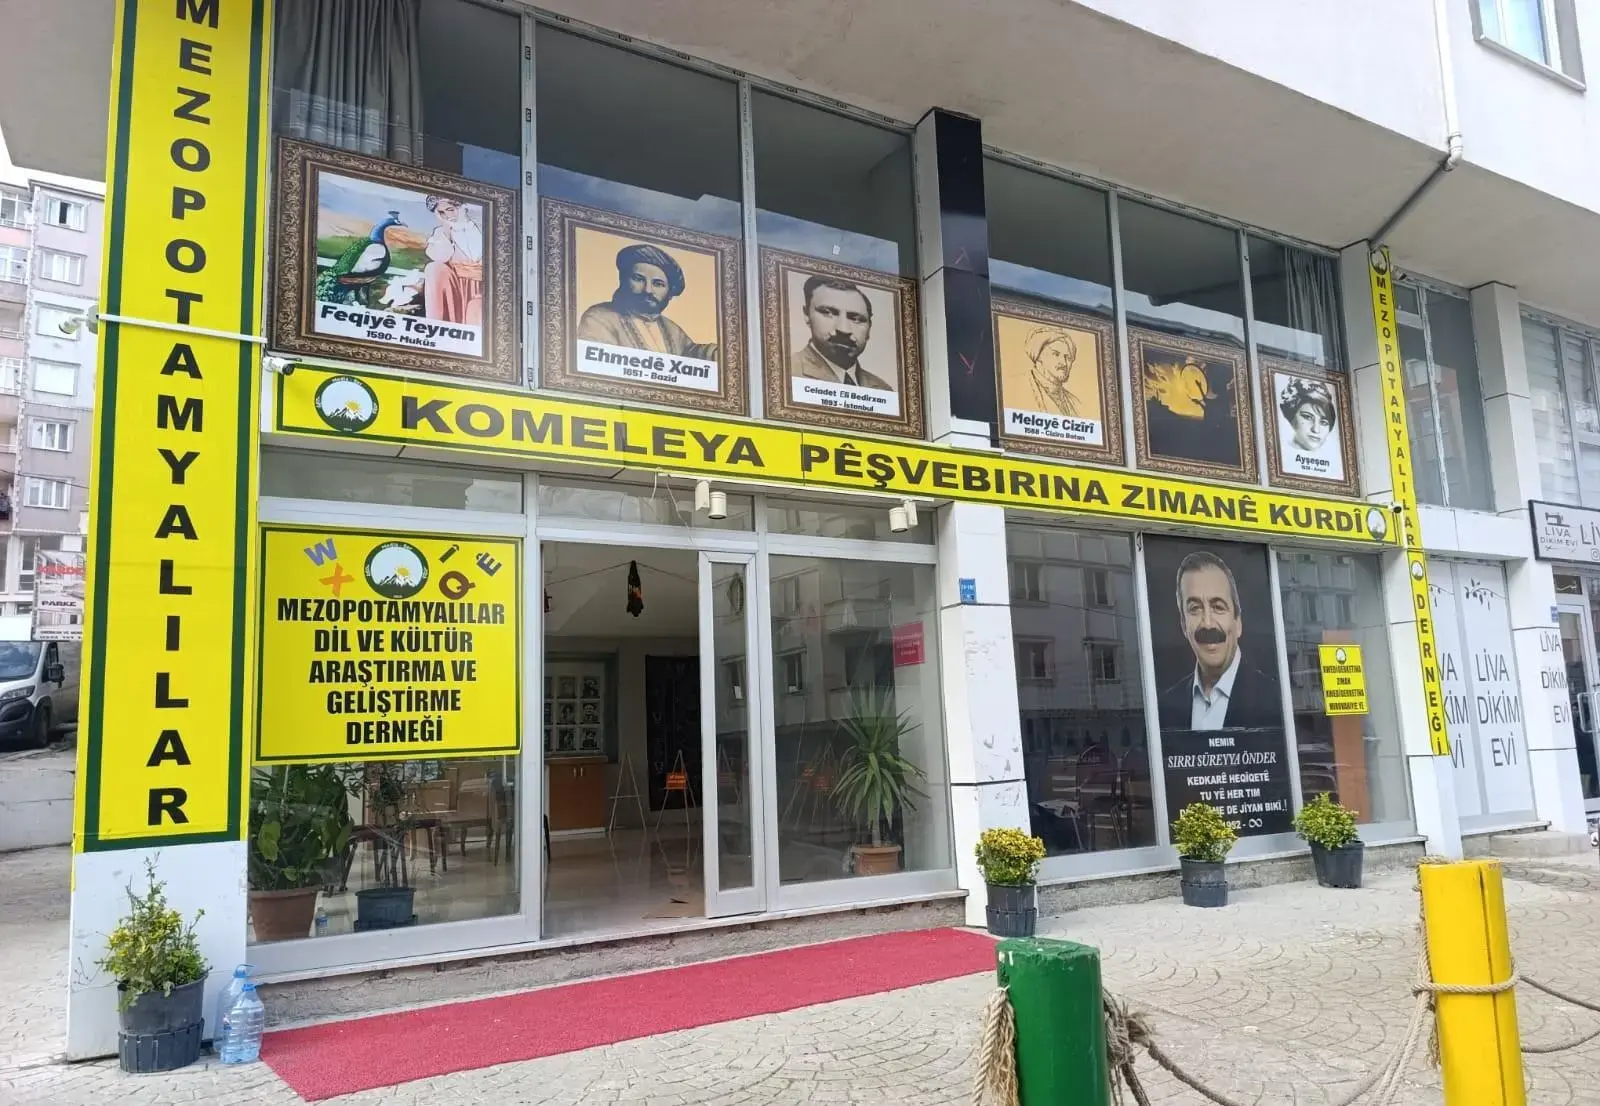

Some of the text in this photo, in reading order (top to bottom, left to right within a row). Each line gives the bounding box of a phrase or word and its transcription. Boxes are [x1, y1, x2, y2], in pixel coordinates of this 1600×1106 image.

[402, 316, 476, 342] Teyran
[584, 345, 712, 379] Ehmedê Xanî
[804, 385, 837, 397] Celadet
[850, 392, 887, 405] Bedirxan
[147, 0, 219, 826] MEZOPOTAMYALILAR
[1011, 411, 1059, 430] Melayê
[1376, 275, 1416, 546] MEZOPOTAMYALILAR
[401, 395, 1363, 533] KOMELEYA PÊŞVEBIRINA ZIMANÊ KURDÎ
[1295, 453, 1330, 467] Ayşeşan
[304, 538, 338, 567] W
[438, 570, 476, 600] Q
[277, 597, 505, 625] MEZOPOTAMYALILAR
[314, 626, 473, 653] DİL VE KÜLTÜR
[308, 659, 477, 687] ARAŞTIRMA VE
[1416, 593, 1443, 756] DERNEĞİ
[1475, 648, 1510, 682] LİVA
[326, 686, 462, 718] GELİŞTİRME
[1476, 690, 1521, 725] DİKİM
[346, 714, 443, 745] DERNEĞİ
[1197, 751, 1241, 768] SÜREYYA
[1241, 750, 1277, 765] ÖNDER
[1491, 731, 1517, 767] EVİ
[1186, 771, 1228, 787] KEDKARÊ
[1199, 787, 1261, 801] TU YÊ HER TIM
[1226, 804, 1239, 815] DE
